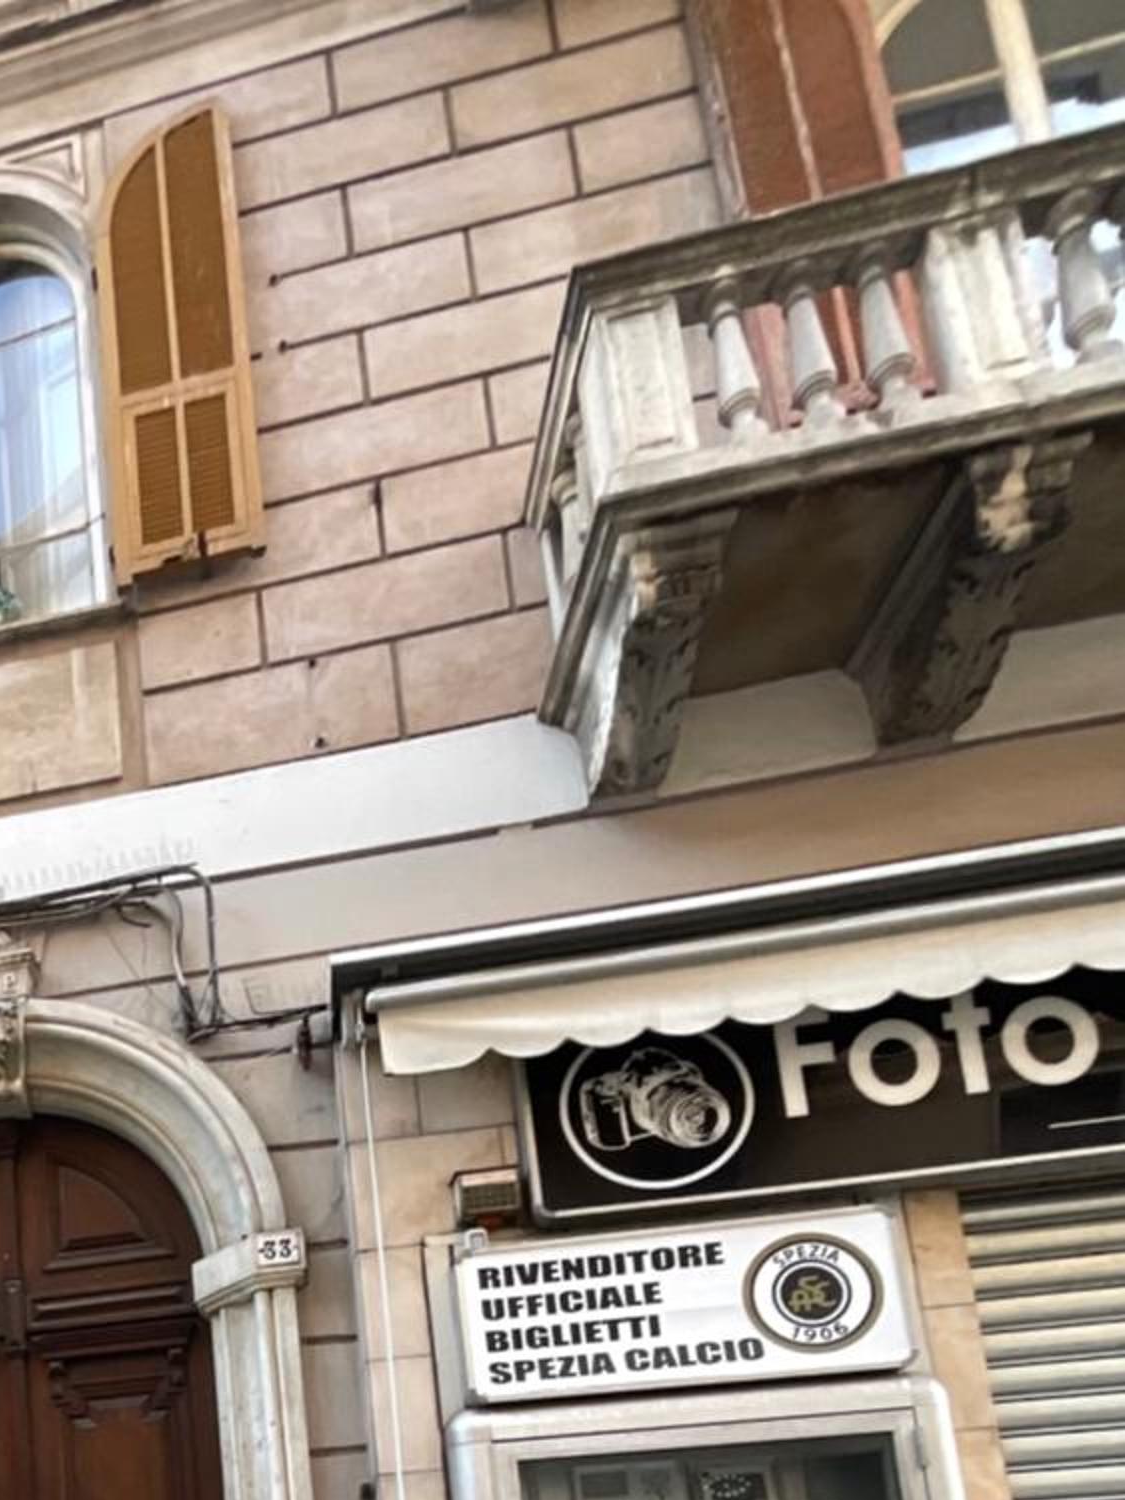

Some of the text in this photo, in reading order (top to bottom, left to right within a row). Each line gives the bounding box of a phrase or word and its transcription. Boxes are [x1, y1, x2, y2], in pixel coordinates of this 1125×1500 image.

[774, 995, 1100, 1118] Foto
[264, 1238, 292, 1260] 33
[477, 1241, 725, 1290] RIVENDITORE
[772, 1244, 840, 1269] SPEZIA
[481, 1281, 663, 1320] UFFICIALE
[485, 1314, 662, 1353] BIGLIETTI
[793, 1320, 849, 1342] 1906
[488, 1337, 765, 1385] SPEZIA CALCIO
